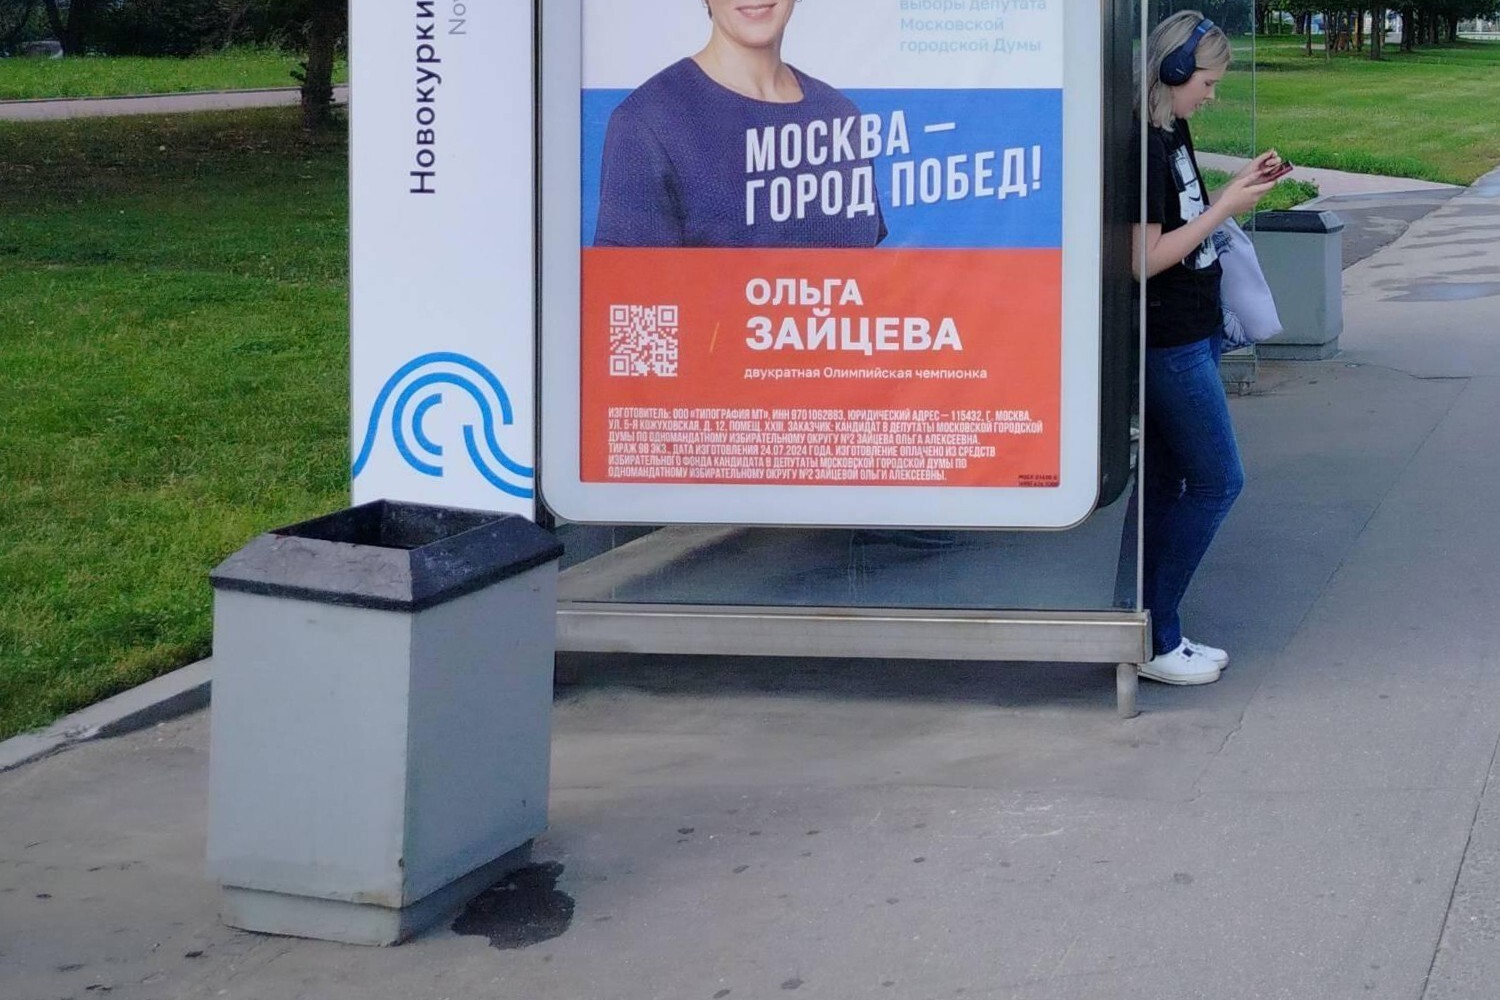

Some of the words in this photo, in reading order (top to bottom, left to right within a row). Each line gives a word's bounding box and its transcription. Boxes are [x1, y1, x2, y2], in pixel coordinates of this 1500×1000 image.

[900, 16, 1004, 31] Московской
[900, 37, 989, 54] городской
[992, 38, 1041, 54] Думы
[746, 110, 910, 173] МОСКВА
[746, 165, 876, 225] ГОРОД
[891, 145, 1042, 207] ПОБЕД!
[745, 277, 864, 306] ОЛЬГА
[745, 307, 964, 355] ЗАЙЦЕВА
[744, 367, 821, 380] двукратная
[823, 366, 913, 380] Олимпийская
[915, 368, 988, 379] чемпионка
[835, 421, 880, 433] КАНДИДАТ
[889, 421, 935, 433] ДЕПУТАТЫ
[937, 420, 993, 433] МОСКОВСКОЙ
[994, 420, 1043, 434] ГОРОДСКОЙ
[637, 431, 648, 442] ПО
[895, 433, 923, 445] ОЛЬГА
[900, 445, 944, 458] ОПЛАЧЕНО
[945, 446, 957, 457] ИЗ
[958, 446, 996, 458] СРЕДСТВ
[876, 456, 925, 469] ГОРОДСКОЙ
[927, 457, 954, 469] ДУМЫ
[955, 458, 967, 469] ПО
